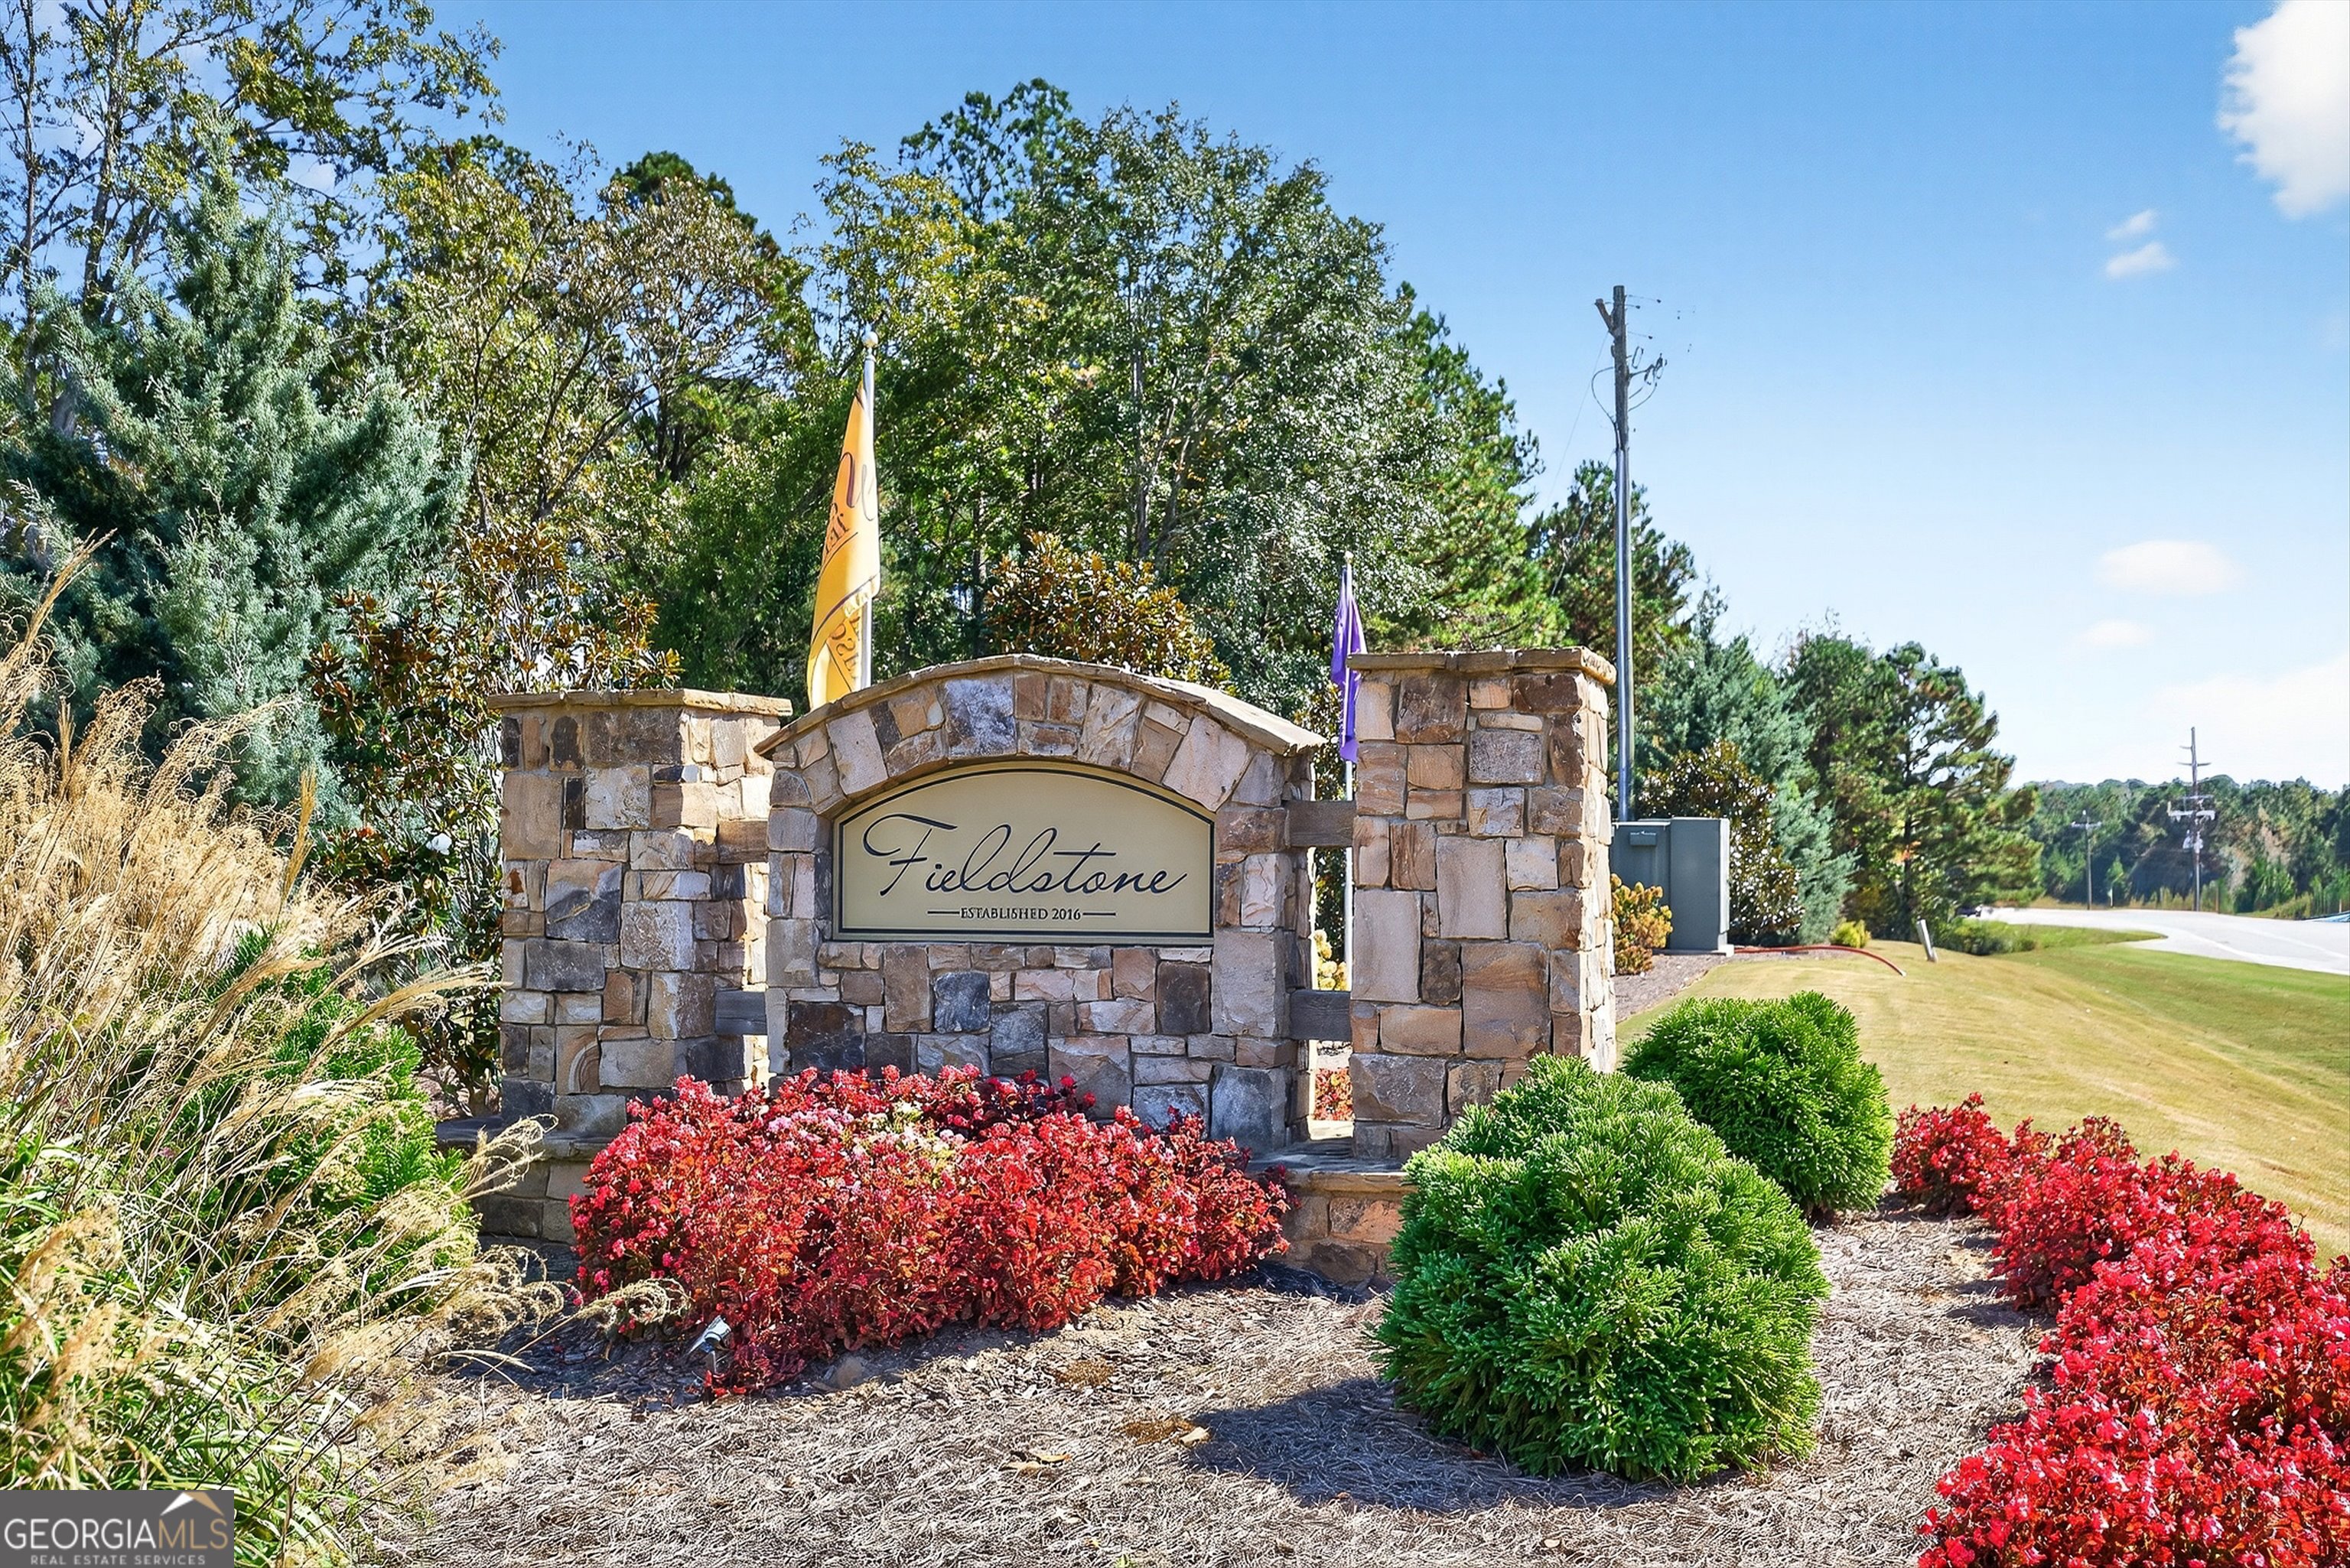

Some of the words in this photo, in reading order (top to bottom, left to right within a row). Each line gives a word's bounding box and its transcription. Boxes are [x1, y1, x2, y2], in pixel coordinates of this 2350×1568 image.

[862, 813, 1188, 896] Fieldstone
[961, 907, 1049, 919] ESTABLISHED
[1052, 908, 1081, 920] 2016
